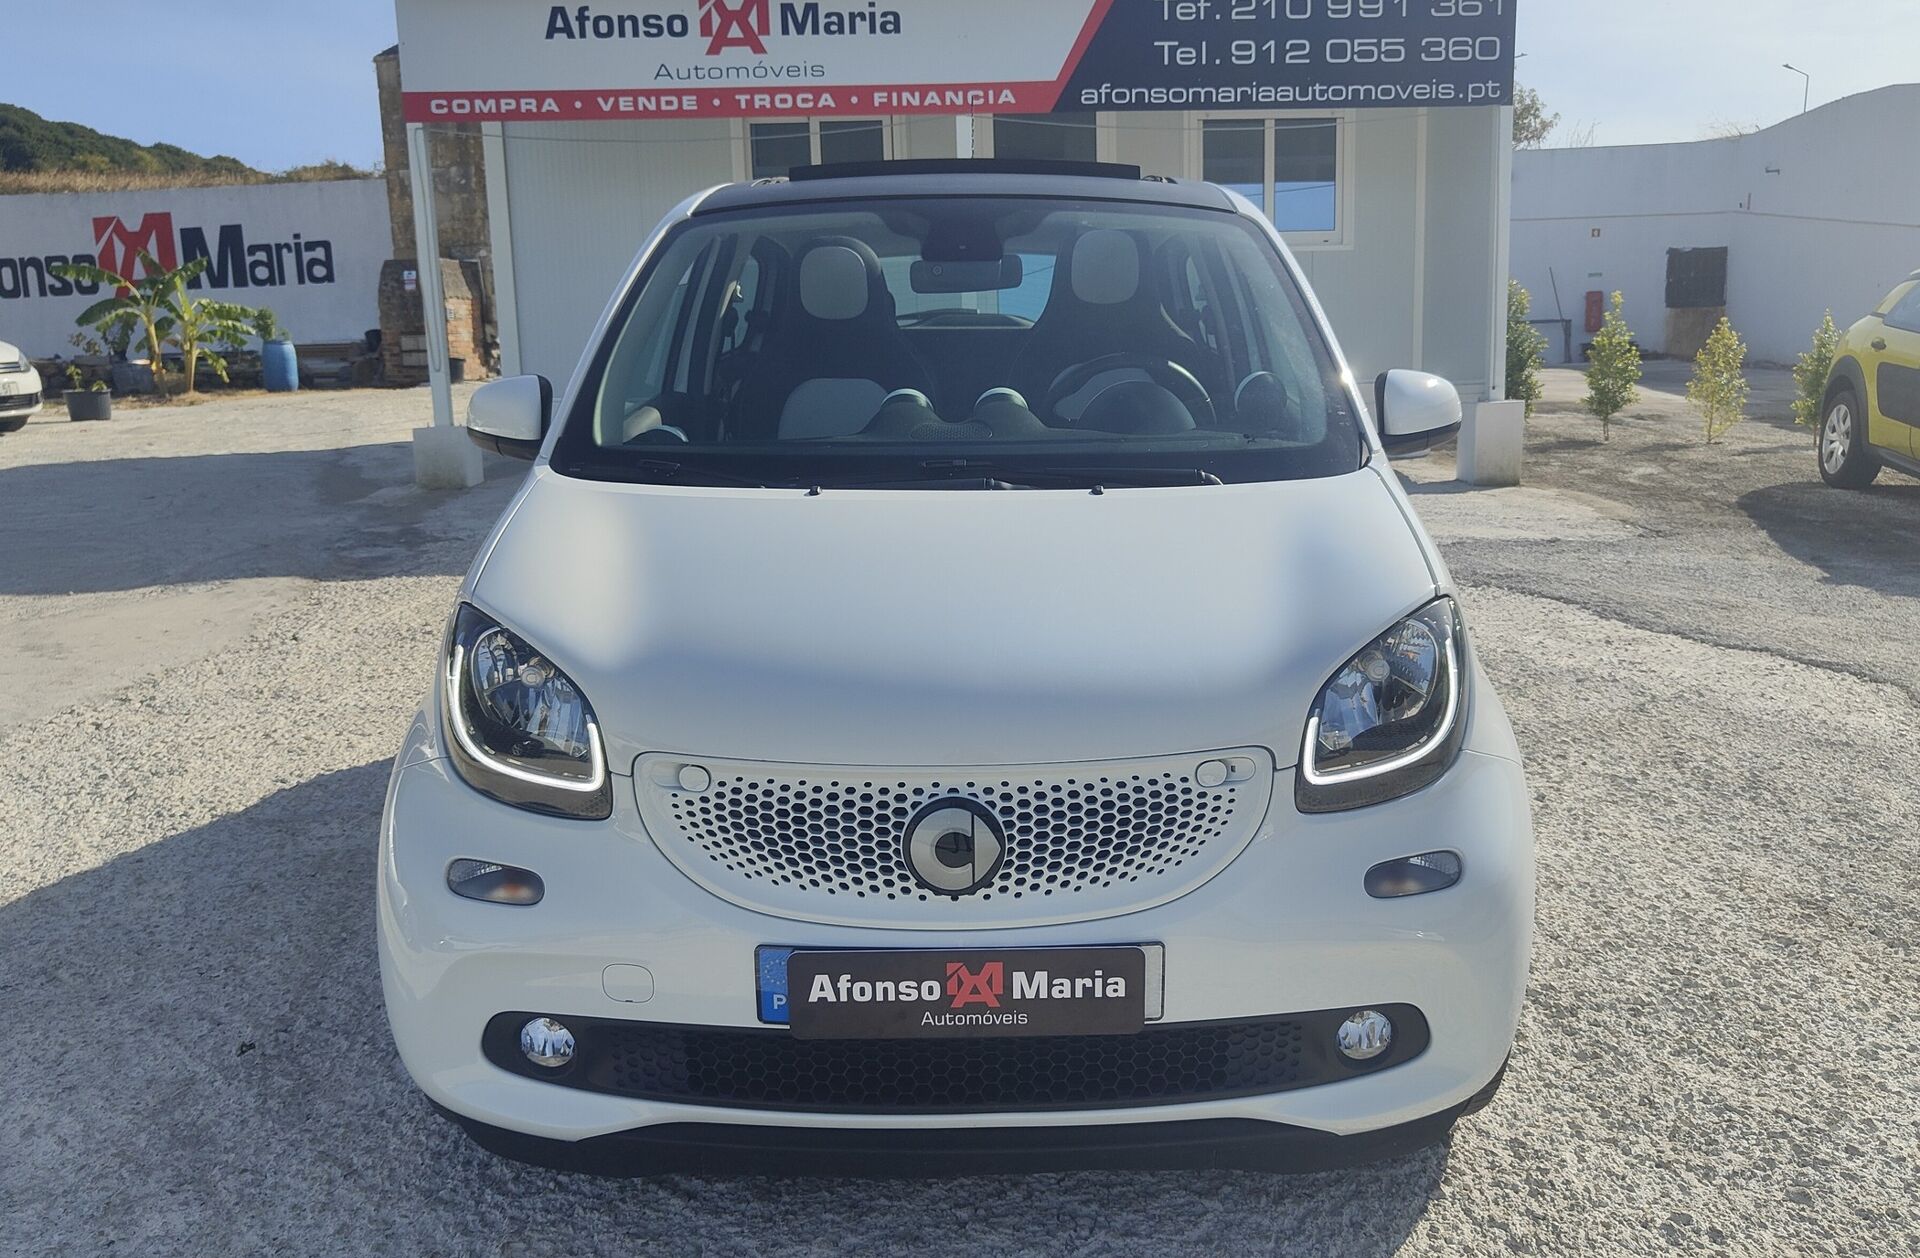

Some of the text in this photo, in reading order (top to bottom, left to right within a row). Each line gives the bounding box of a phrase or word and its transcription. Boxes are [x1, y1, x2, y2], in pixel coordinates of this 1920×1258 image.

[545, 5, 689, 40] Afonso
[780, 2, 901, 36] Maria
[1231, 0, 1312, 20] 210
[1327, 0, 1407, 18] 991
[1430, 0, 1502, 17] 361
[1153, 36, 1501, 66] Tel. 912 055 360
[653, 60, 826, 81] Automóveis
[430, 89, 1017, 115] COMPRA VENDE TROCA FINANCIA
[1080, 80, 1501, 105] afonsomariaautomoveis.pt
[180, 223, 335, 290] Maria
[808, 974, 942, 1003] Afonso
[1012, 969, 1126, 1000] Maria
[773, 993, 787, 1010] P
[920, 1010, 1028, 1027] Automóveis
